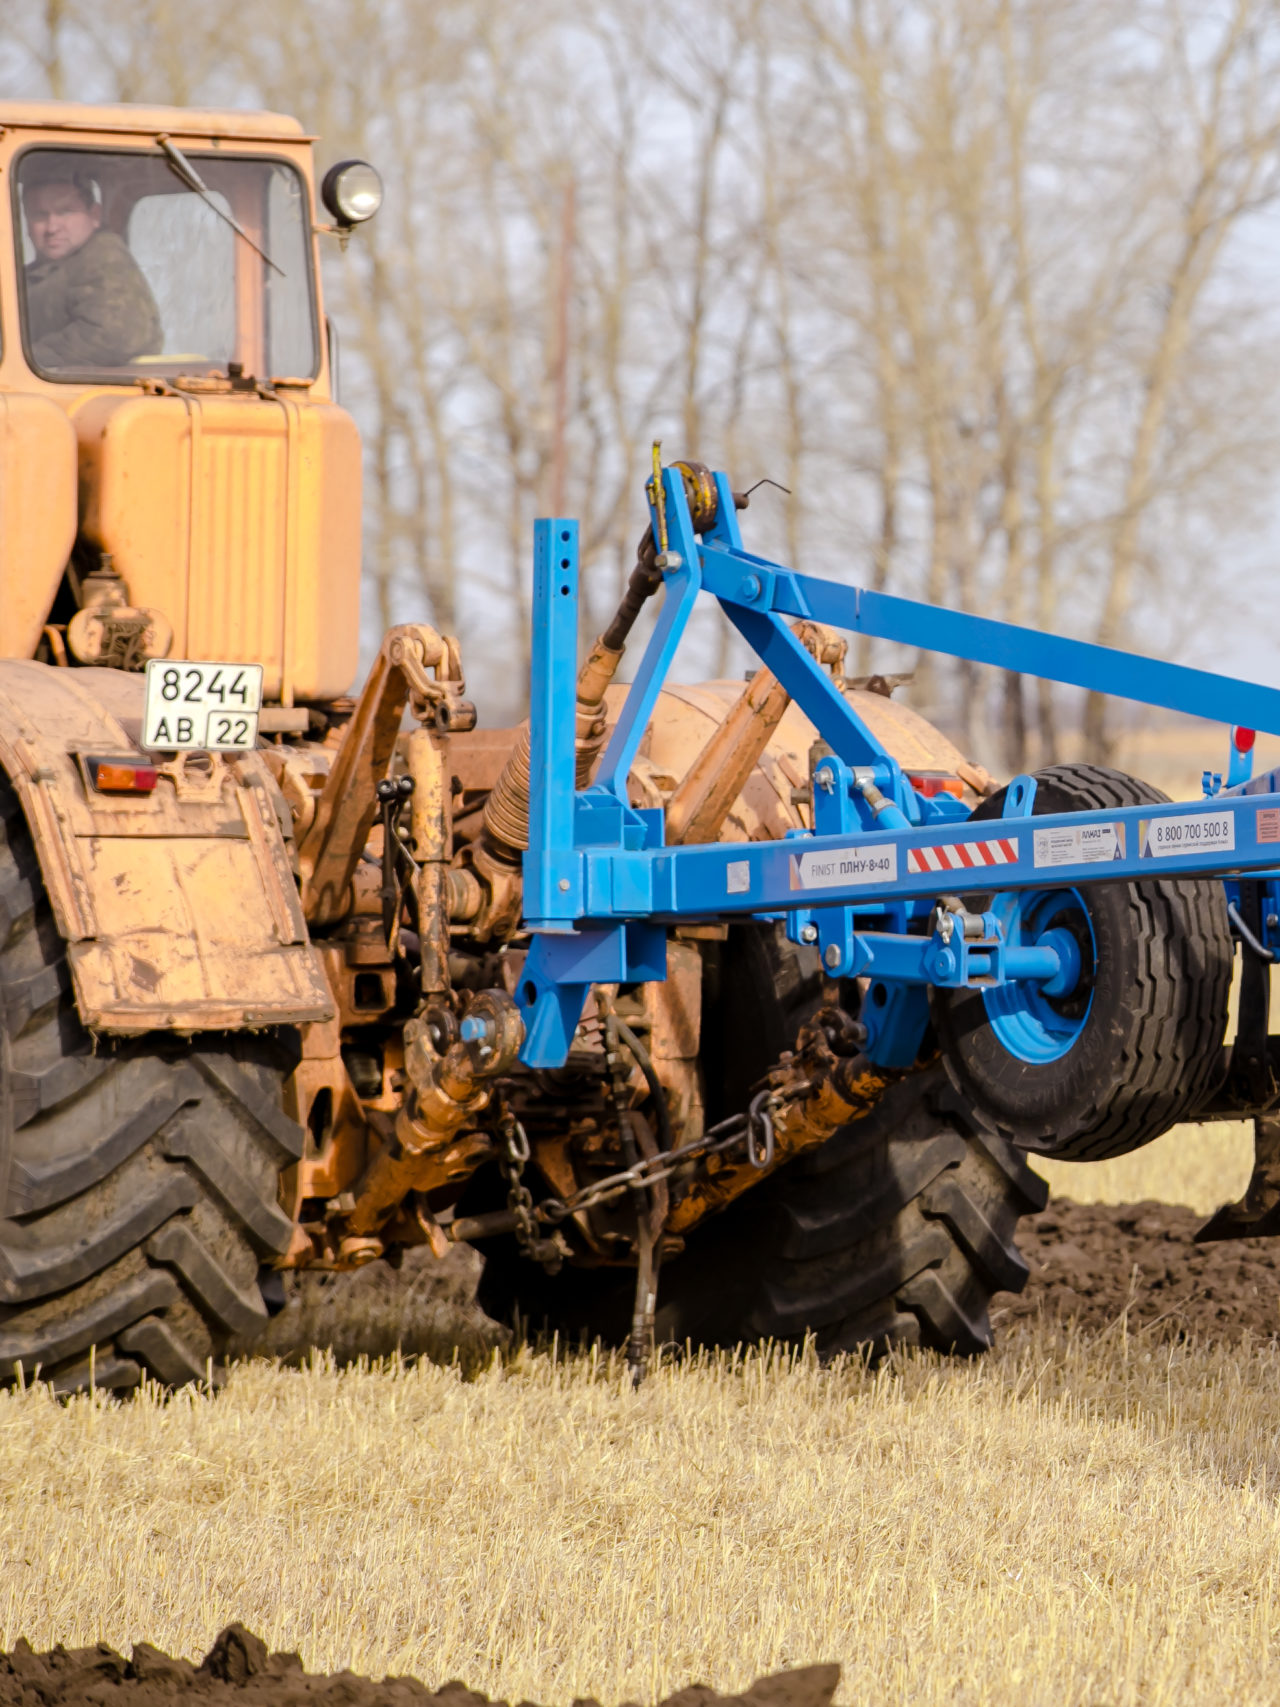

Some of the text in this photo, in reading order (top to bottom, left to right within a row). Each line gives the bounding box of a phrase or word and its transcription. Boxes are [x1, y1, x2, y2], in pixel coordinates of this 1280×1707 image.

[162, 669, 247, 704] 8244
[153, 716, 248, 744] АВ 22
[1157, 821, 1228, 842] 8 800 700 500 8
[811, 863, 836, 877] FINIST
